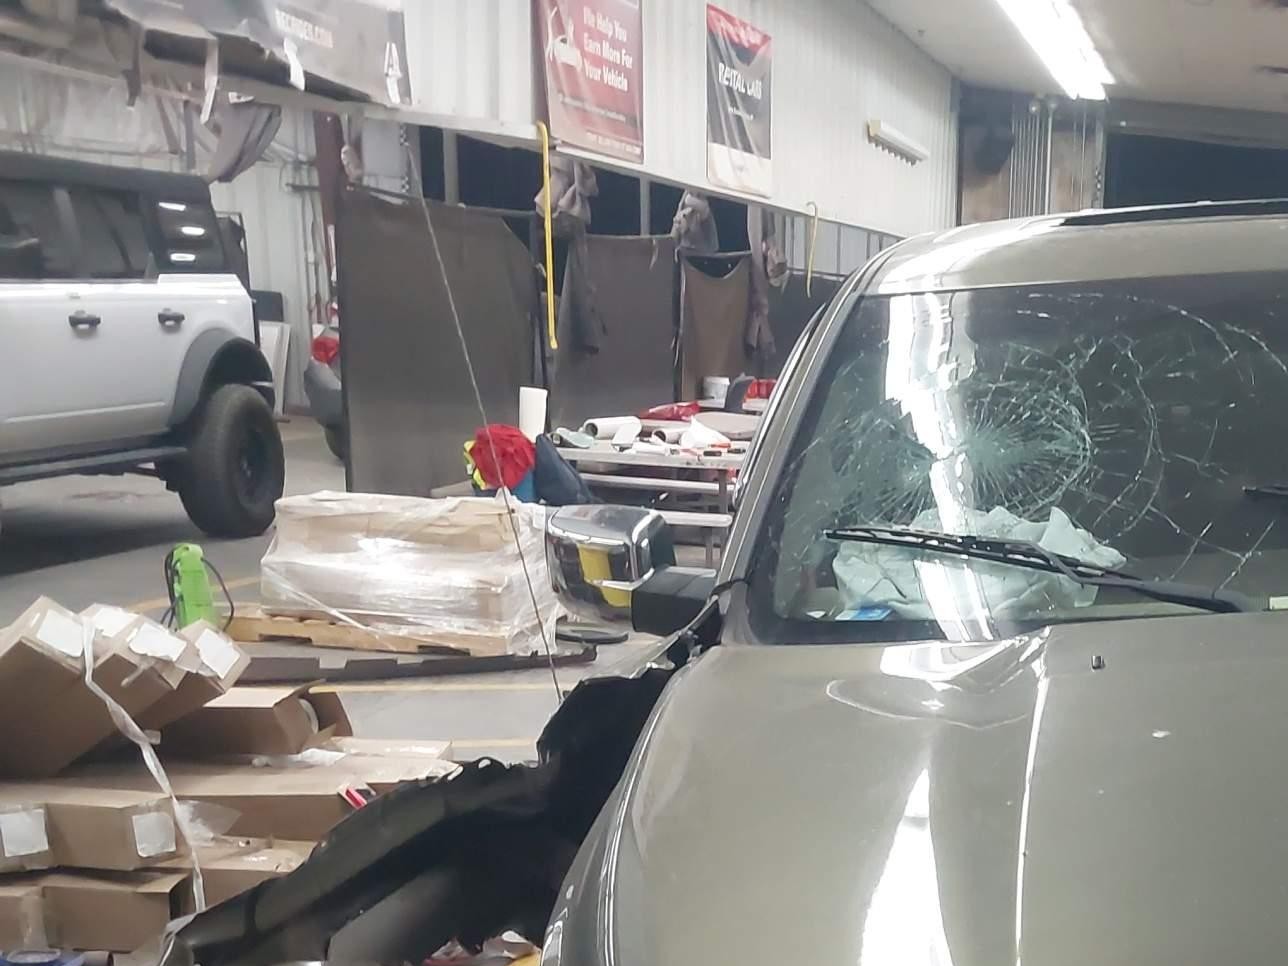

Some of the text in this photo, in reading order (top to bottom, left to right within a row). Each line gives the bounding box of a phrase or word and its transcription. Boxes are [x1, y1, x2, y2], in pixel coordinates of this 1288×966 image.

[596, 11, 614, 38] Help
[614, 20, 627, 42] You
[583, 32, 633, 69] Earn More For
[583, 58, 628, 92] Your Vehicle
